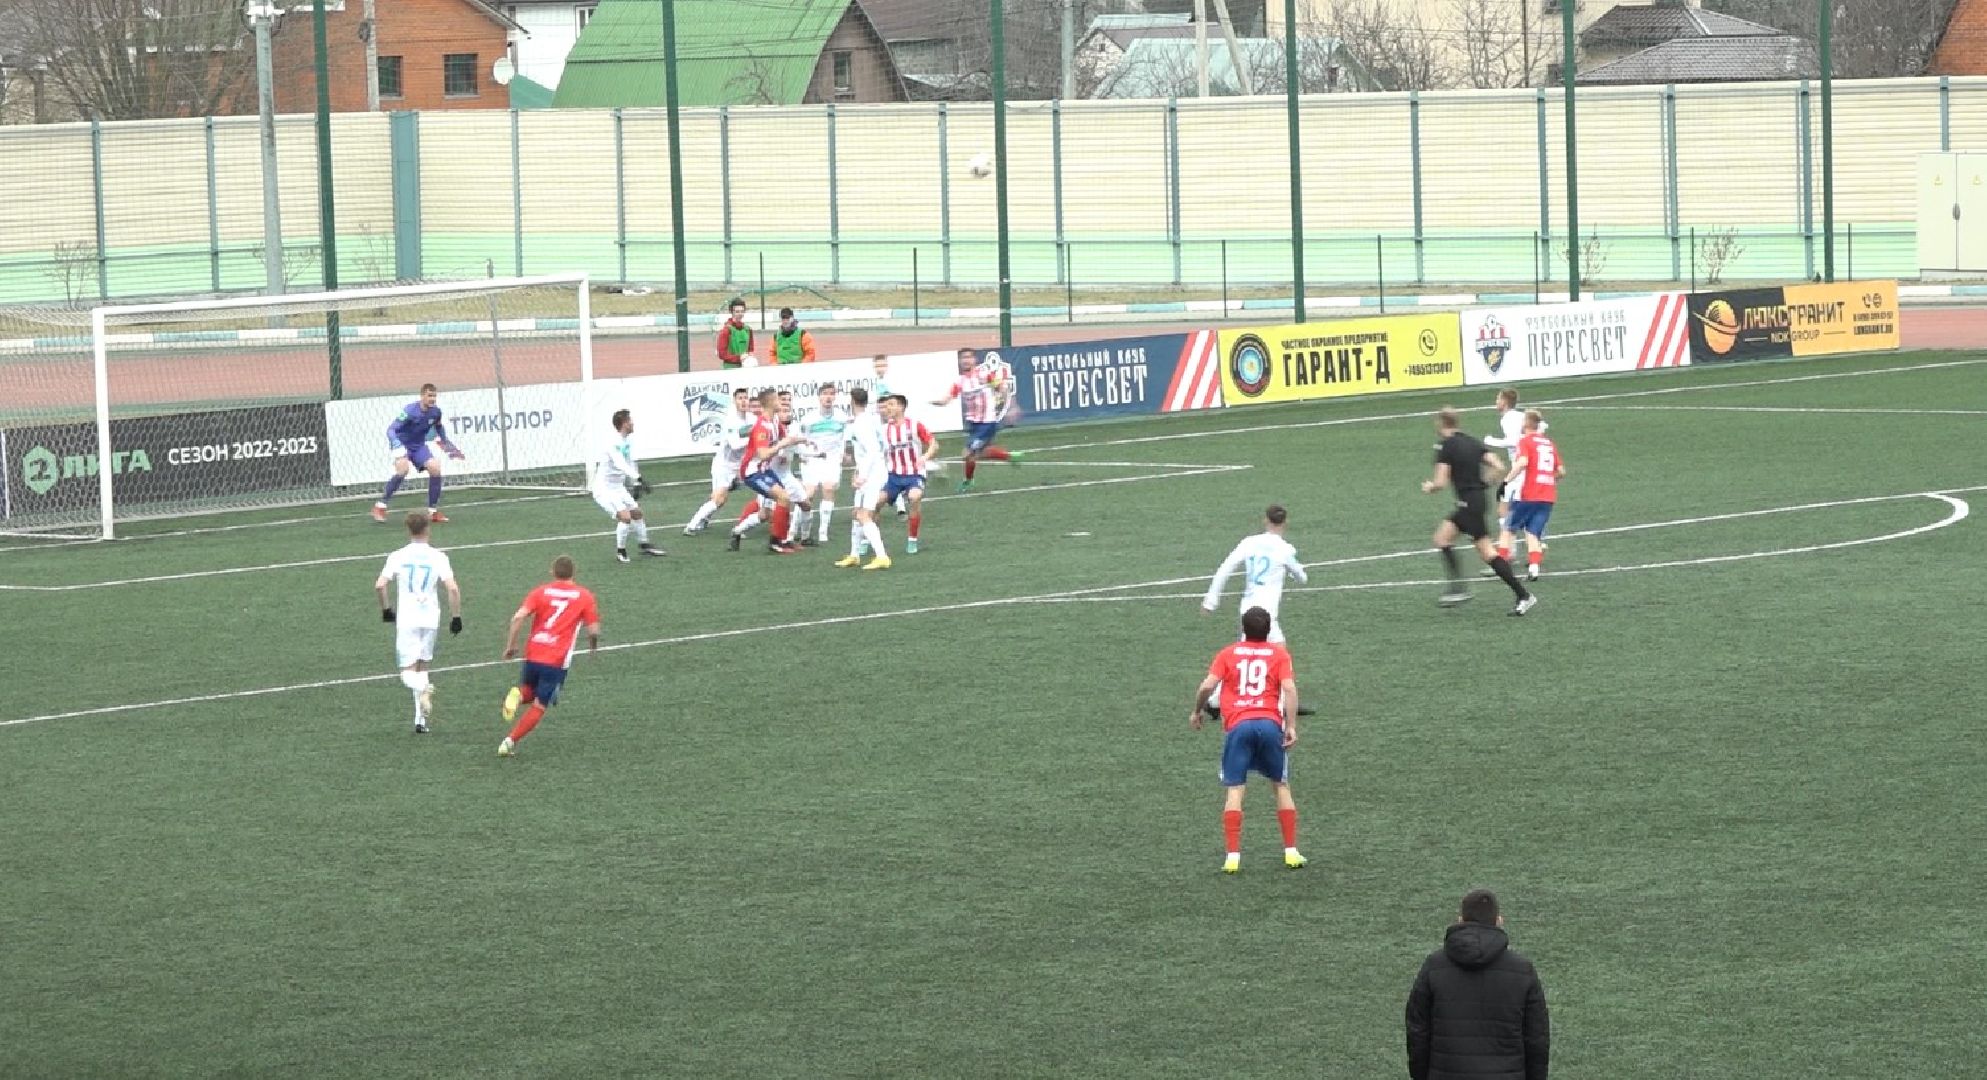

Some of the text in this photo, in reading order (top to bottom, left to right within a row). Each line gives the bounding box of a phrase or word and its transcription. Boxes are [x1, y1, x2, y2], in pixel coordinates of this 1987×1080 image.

[1032, 347, 1146, 371] ФУТБОЛЬНЫЙ КЛУБ
[1528, 326, 1627, 368] ПЕРЕСВЕТ
[1283, 345, 1390, 387] ГАРАНТ-Д
[1033, 365, 1147, 411] ПЕРЕСВЕТ
[450, 410, 552, 434] ТРИКОЛОР
[168, 436, 318, 465] СЕЗОН 2022-2023
[401, 564, 432, 593] 77
[1248, 555, 1270, 586] 12
[547, 600, 568, 628] 7
[1236, 658, 1267, 696] 19
